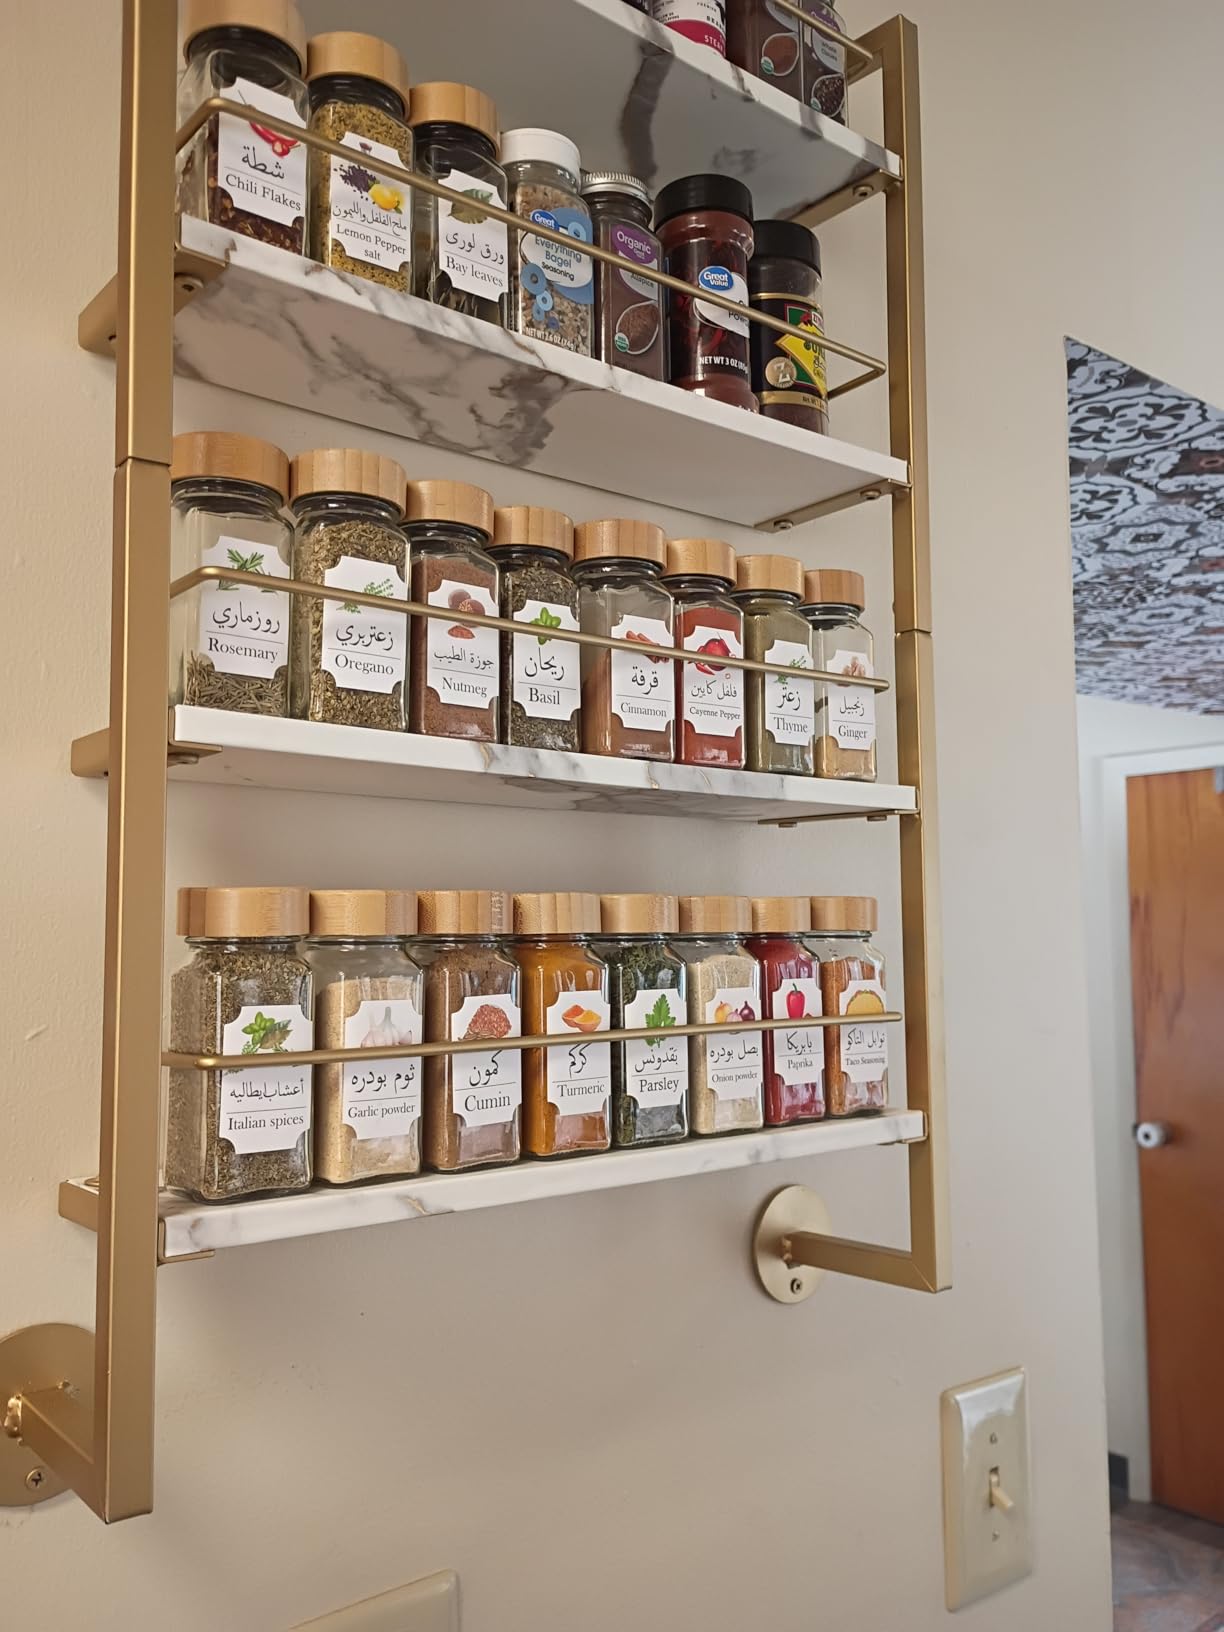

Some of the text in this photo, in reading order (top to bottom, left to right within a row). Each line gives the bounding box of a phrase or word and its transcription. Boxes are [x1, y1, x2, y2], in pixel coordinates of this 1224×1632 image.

[241, 145, 285, 180] شطة
[225, 172, 302, 212] Chili Flakes
[534, 212, 556, 228] Great
[336, 223, 406, 255] Lemon Pepper
[616, 230, 652, 255] Organic
[364, 248, 381, 261] salt
[480, 243, 505, 265] ورق
[545, 249, 572, 269] Bagel
[446, 255, 504, 288] Bay leaves
[541, 261, 575, 282] Seasoning
[703, 271, 728, 282] Great
[709, 278, 729, 287] Value
[699, 355, 712, 365] NET
[713, 356, 725, 366] WT
[725, 356, 730, 366] 3
[730, 357, 739, 369] OZ
[212, 601, 281, 634] روزماري
[207, 636, 279, 664] Rosemary
[433, 645, 495, 671] جوزة الطيب
[334, 654, 395, 676] Oregano
[524, 647, 565, 681] ريحان
[442, 676, 488, 698] Nutmeg
[631, 664, 660, 695] قرفة
[528, 687, 561, 706] Basil
[717, 681, 738, 701] فلفل
[776, 682, 802, 712] زعتر
[620, 701, 668, 718] Cinnamon
[689, 706, 741, 721] Cayenne Pepper
[839, 695, 865, 717] زنجبيل
[773, 716, 809, 735] Thyme
[838, 724, 869, 740] Ginger
[737, 1039, 759, 1060] بصل
[469, 1049, 503, 1087] كمون
[787, 1058, 814, 1071] Paprika
[845, 1057, 861, 1067] Taco
[393, 1063, 415, 1094] ثوم
[639, 1077, 680, 1094] Parsley
[711, 1070, 758, 1083] Onion powder
[556, 1080, 606, 1098] Turmeric
[348, 1103, 416, 1120] Garlic powder
[464, 1090, 511, 1112] Cumin
[228, 1113, 304, 1132] Italian spices
